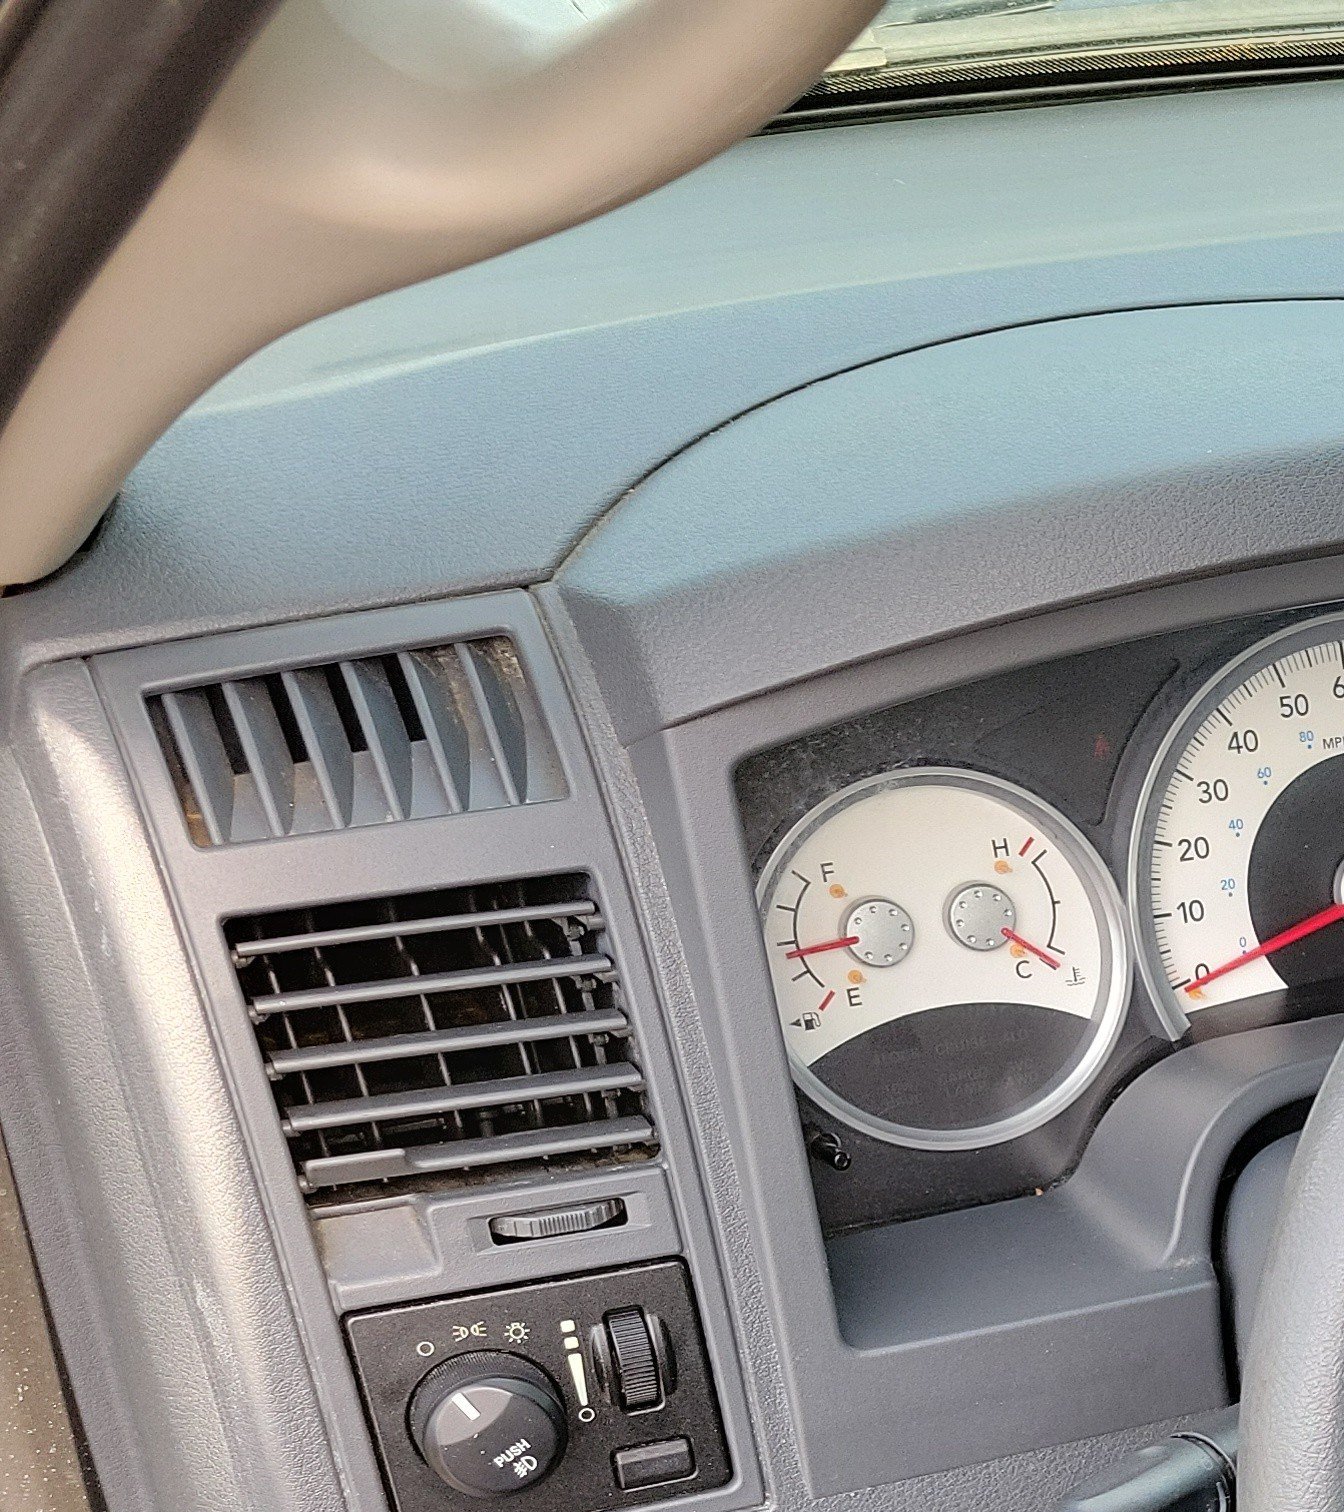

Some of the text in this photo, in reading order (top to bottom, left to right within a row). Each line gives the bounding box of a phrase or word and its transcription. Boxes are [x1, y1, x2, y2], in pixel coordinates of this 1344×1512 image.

[1280, 694, 1310, 718] 50
[1227, 729, 1259, 755] 40
[1299, 731, 1314, 743] 80
[1257, 767, 1272, 780] 60
[1197, 778, 1229, 804] 30
[1229, 819, 1244, 832] 40
[992, 838, 1010, 858] H
[1178, 836, 1210, 863] 20
[821, 862, 834, 882] F
[1221, 878, 1236, 891] 20
[1176, 899, 1205, 923] 10
[1239, 937, 1247, 947] 0
[1016, 960, 1032, 978] C
[847, 987, 862, 1007] E
[493, 1438, 531, 1468] PUSH
